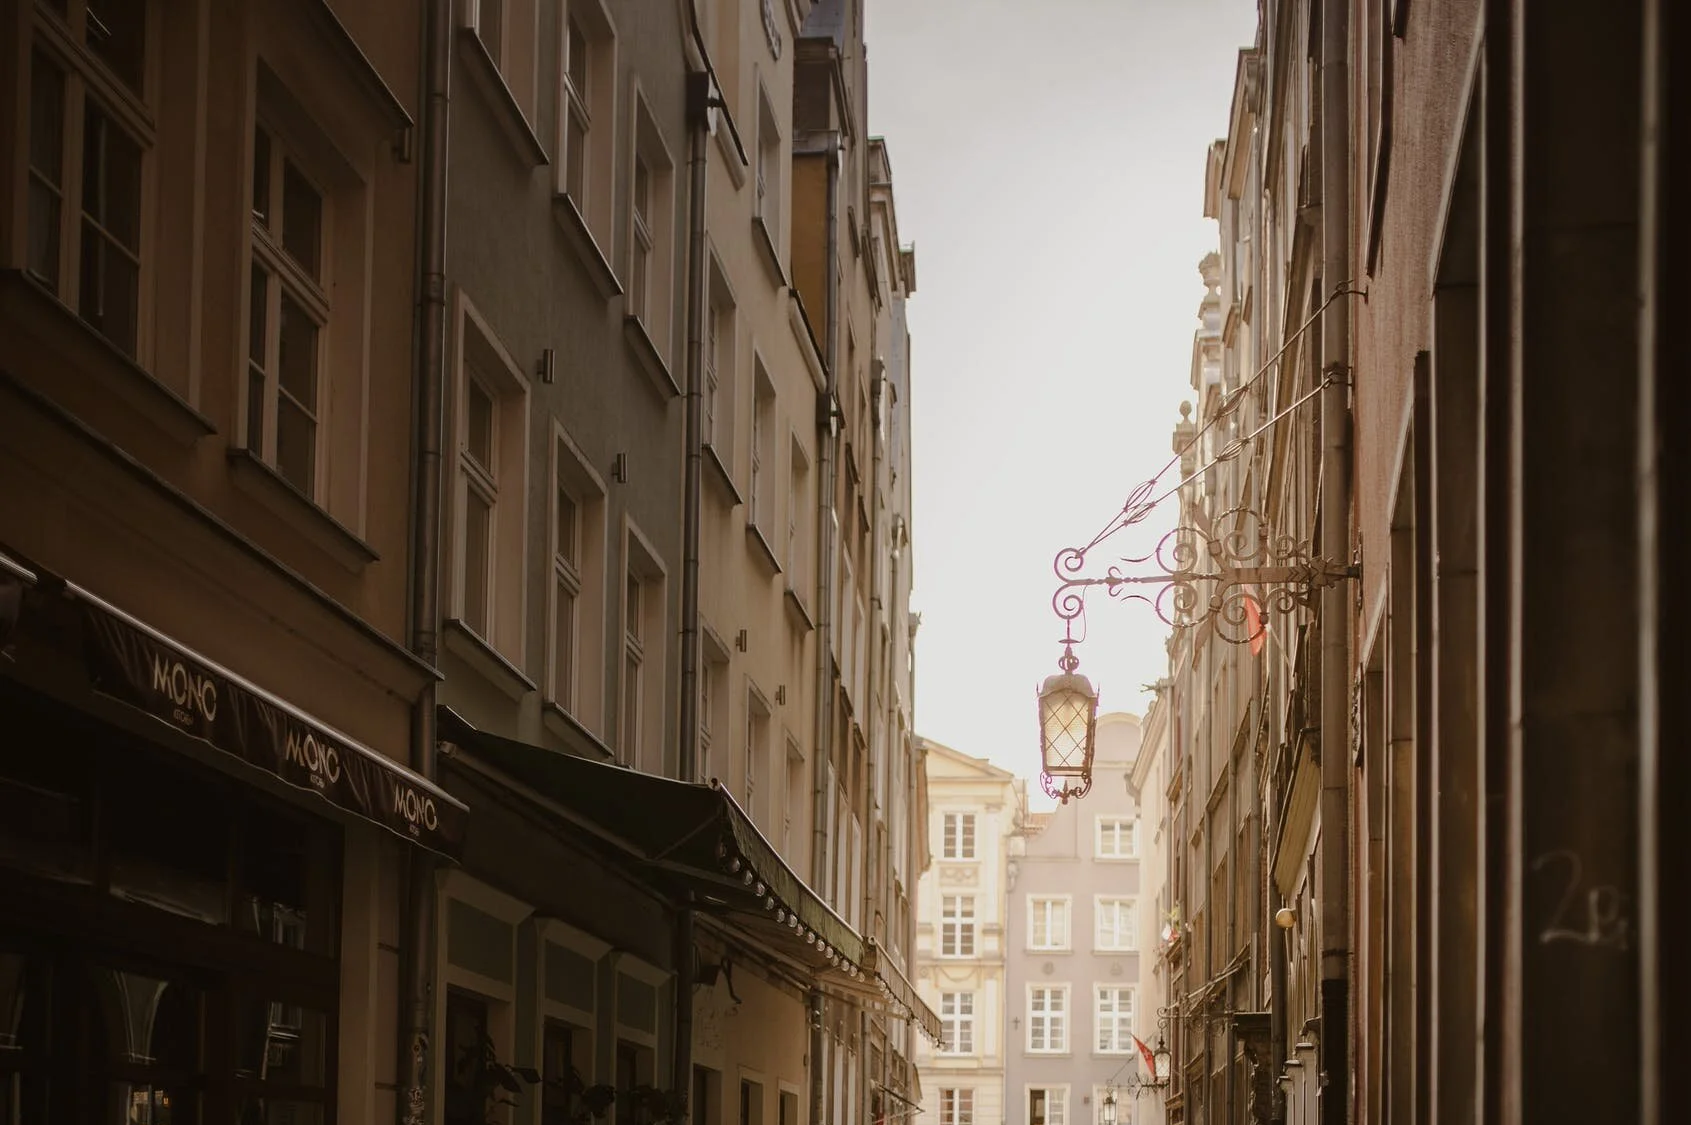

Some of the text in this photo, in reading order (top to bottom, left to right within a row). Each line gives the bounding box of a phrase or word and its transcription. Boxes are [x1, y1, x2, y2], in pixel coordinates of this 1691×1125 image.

[154, 653, 217, 722] MONO
[286, 728, 341, 783] MONO
[394, 782, 438, 832] MONO
